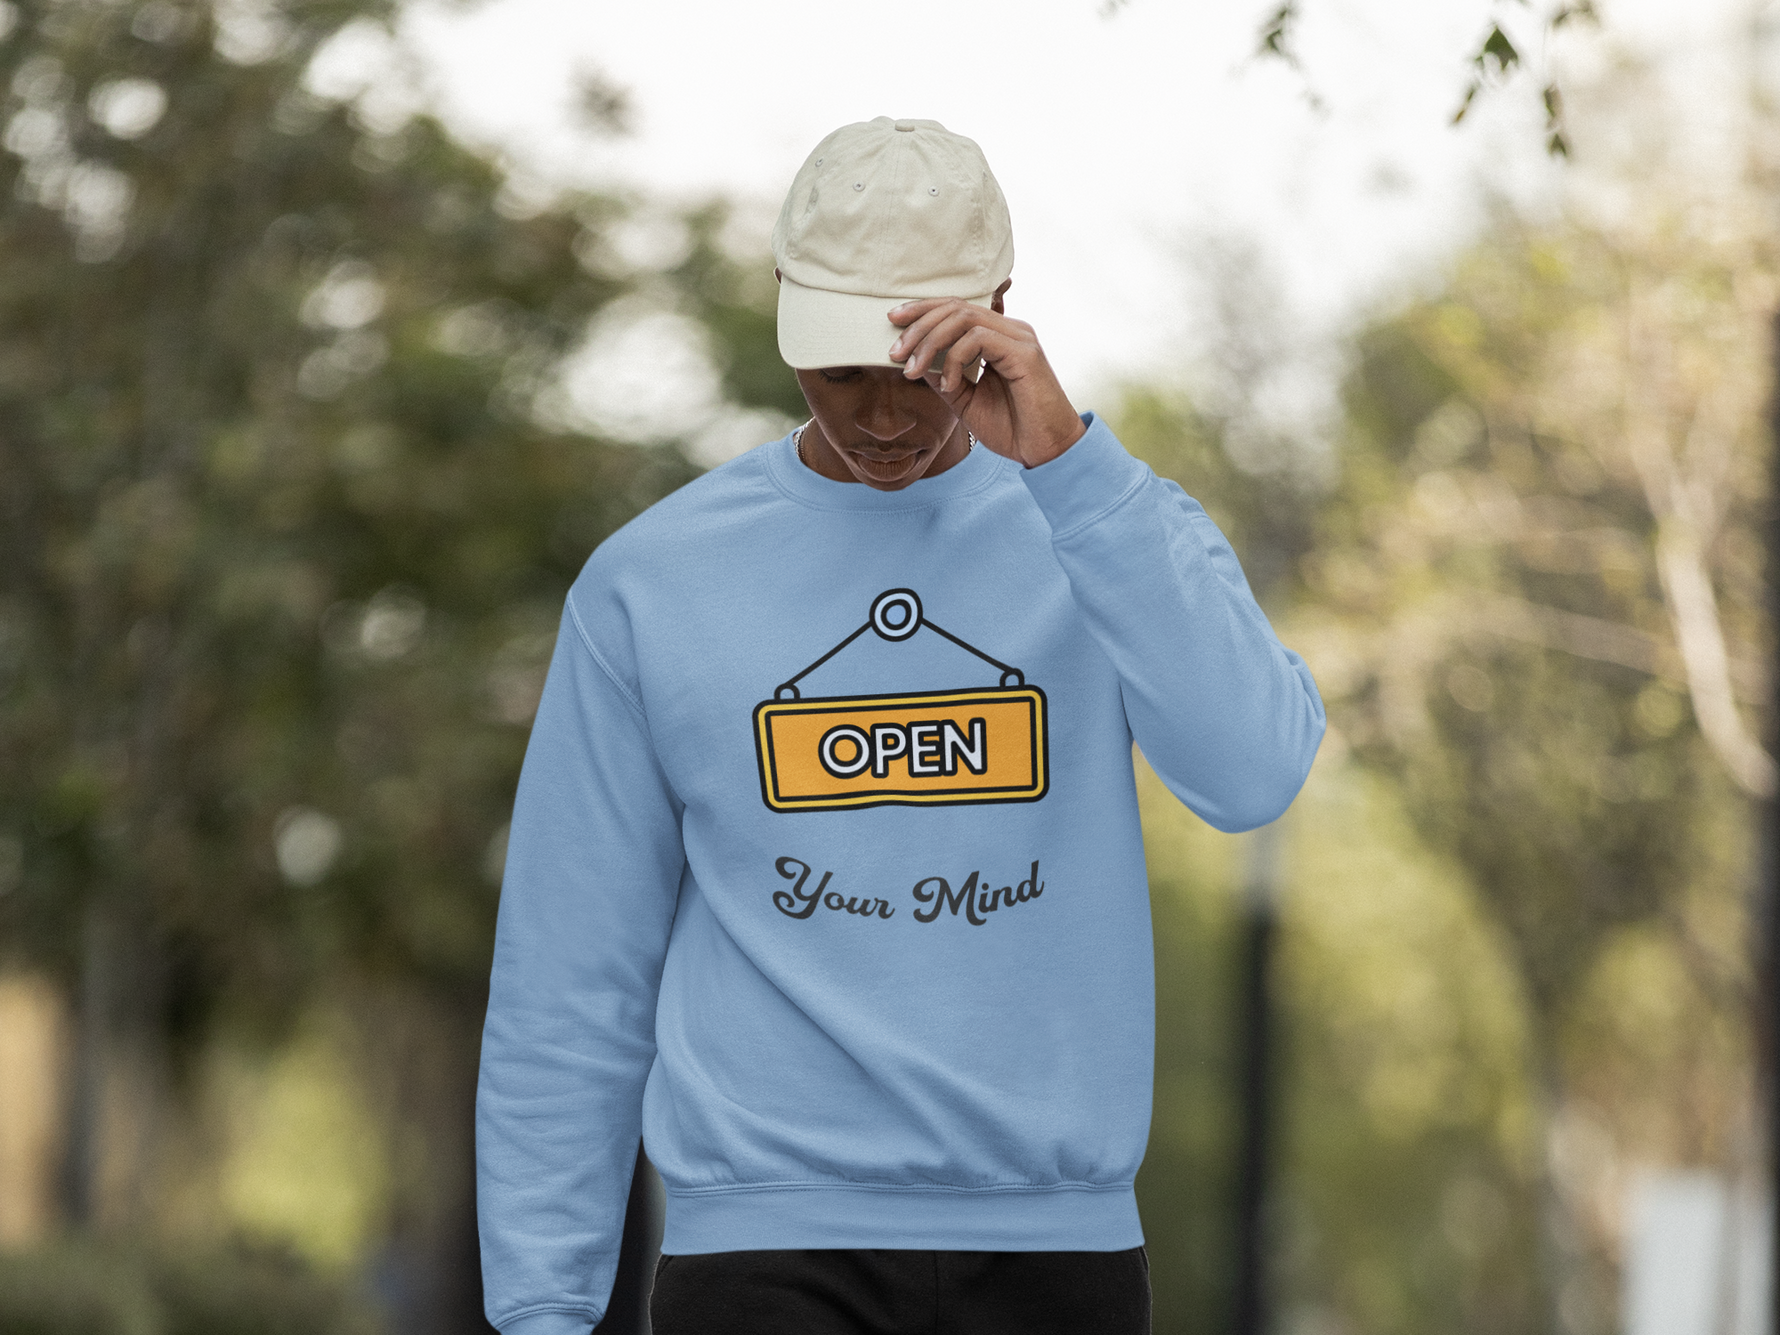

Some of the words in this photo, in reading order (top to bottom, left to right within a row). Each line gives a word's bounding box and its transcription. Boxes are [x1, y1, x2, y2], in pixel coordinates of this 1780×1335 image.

[819, 718, 987, 779] OPEN
[772, 856, 895, 920] Your
[912, 859, 1045, 926] Mind
